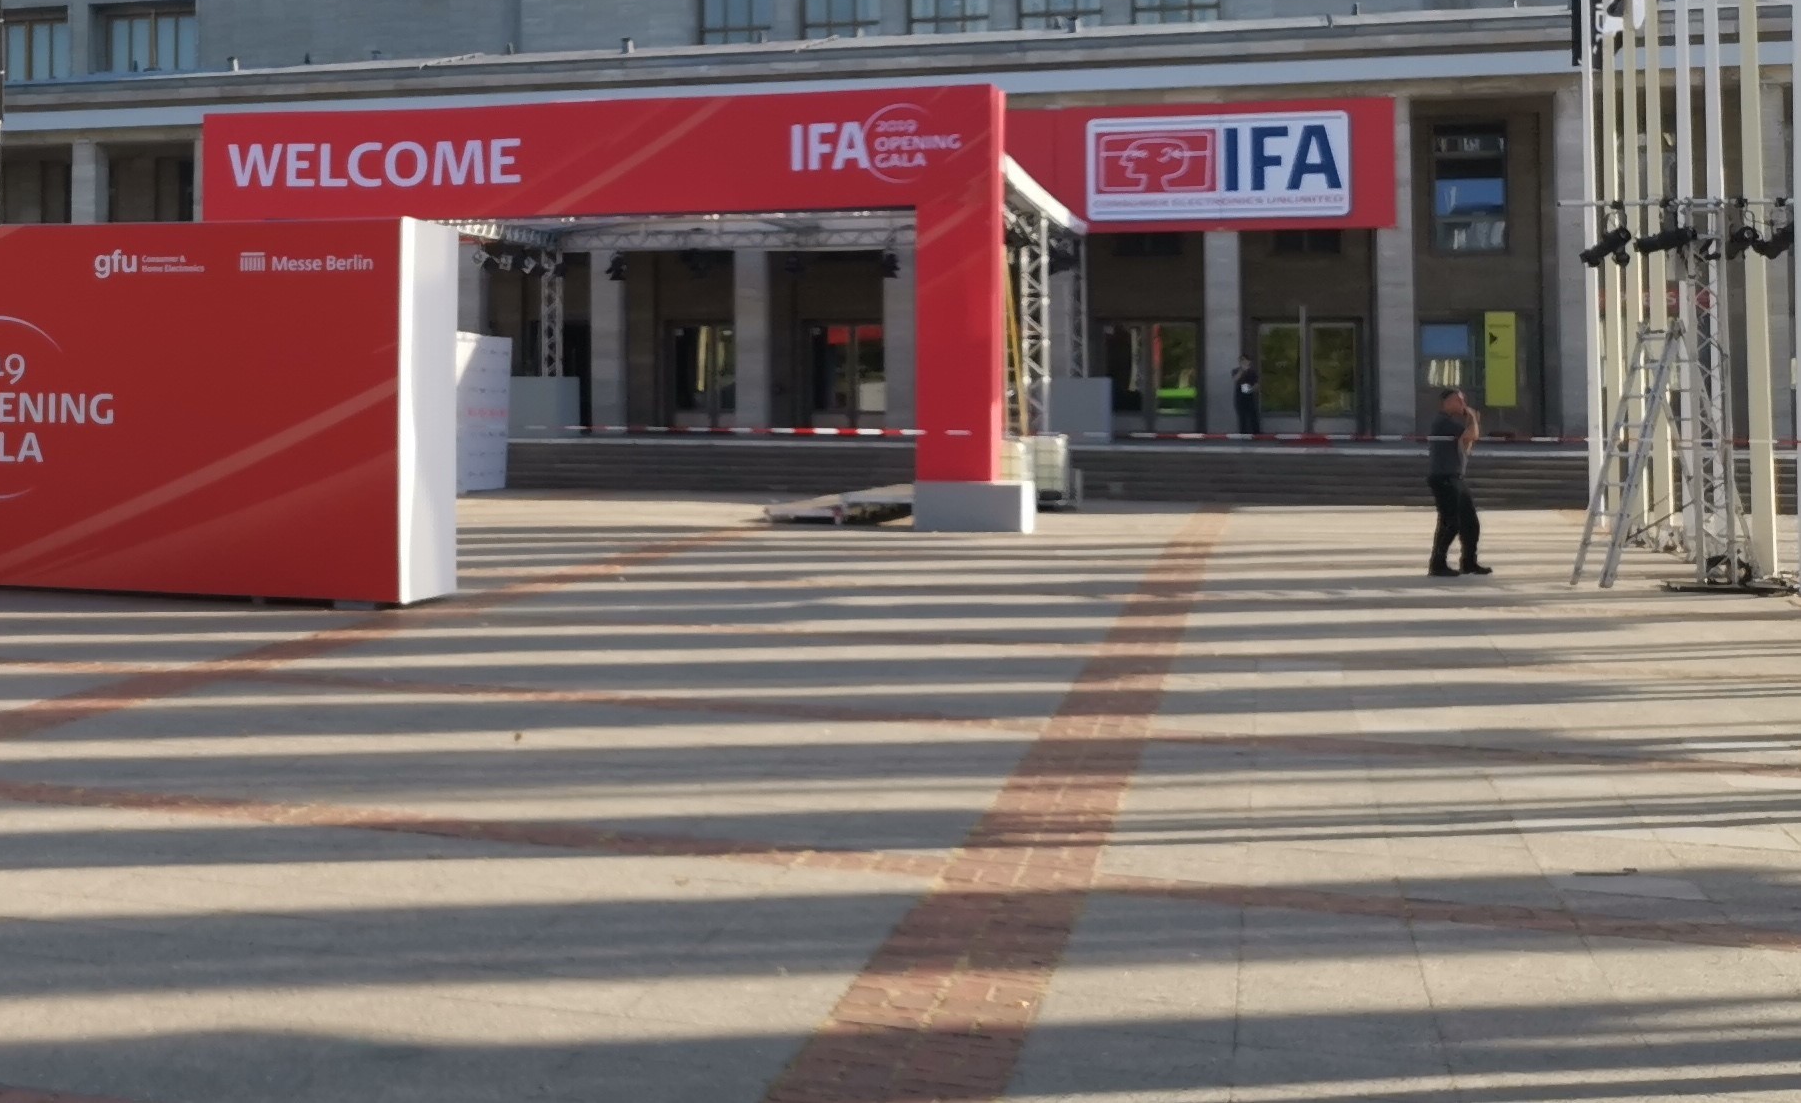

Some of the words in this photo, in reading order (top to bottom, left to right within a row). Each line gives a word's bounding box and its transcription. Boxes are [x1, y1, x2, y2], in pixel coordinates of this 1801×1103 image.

[790, 121, 871, 172] IFA
[873, 133, 963, 152] OPENING
[1224, 124, 1343, 192] IFA
[227, 137, 522, 189] WELCOME
[873, 151, 928, 169] GALA
[93, 248, 138, 279] gfu
[271, 255, 322, 272] Messe
[326, 253, 374, 271] Berlin
